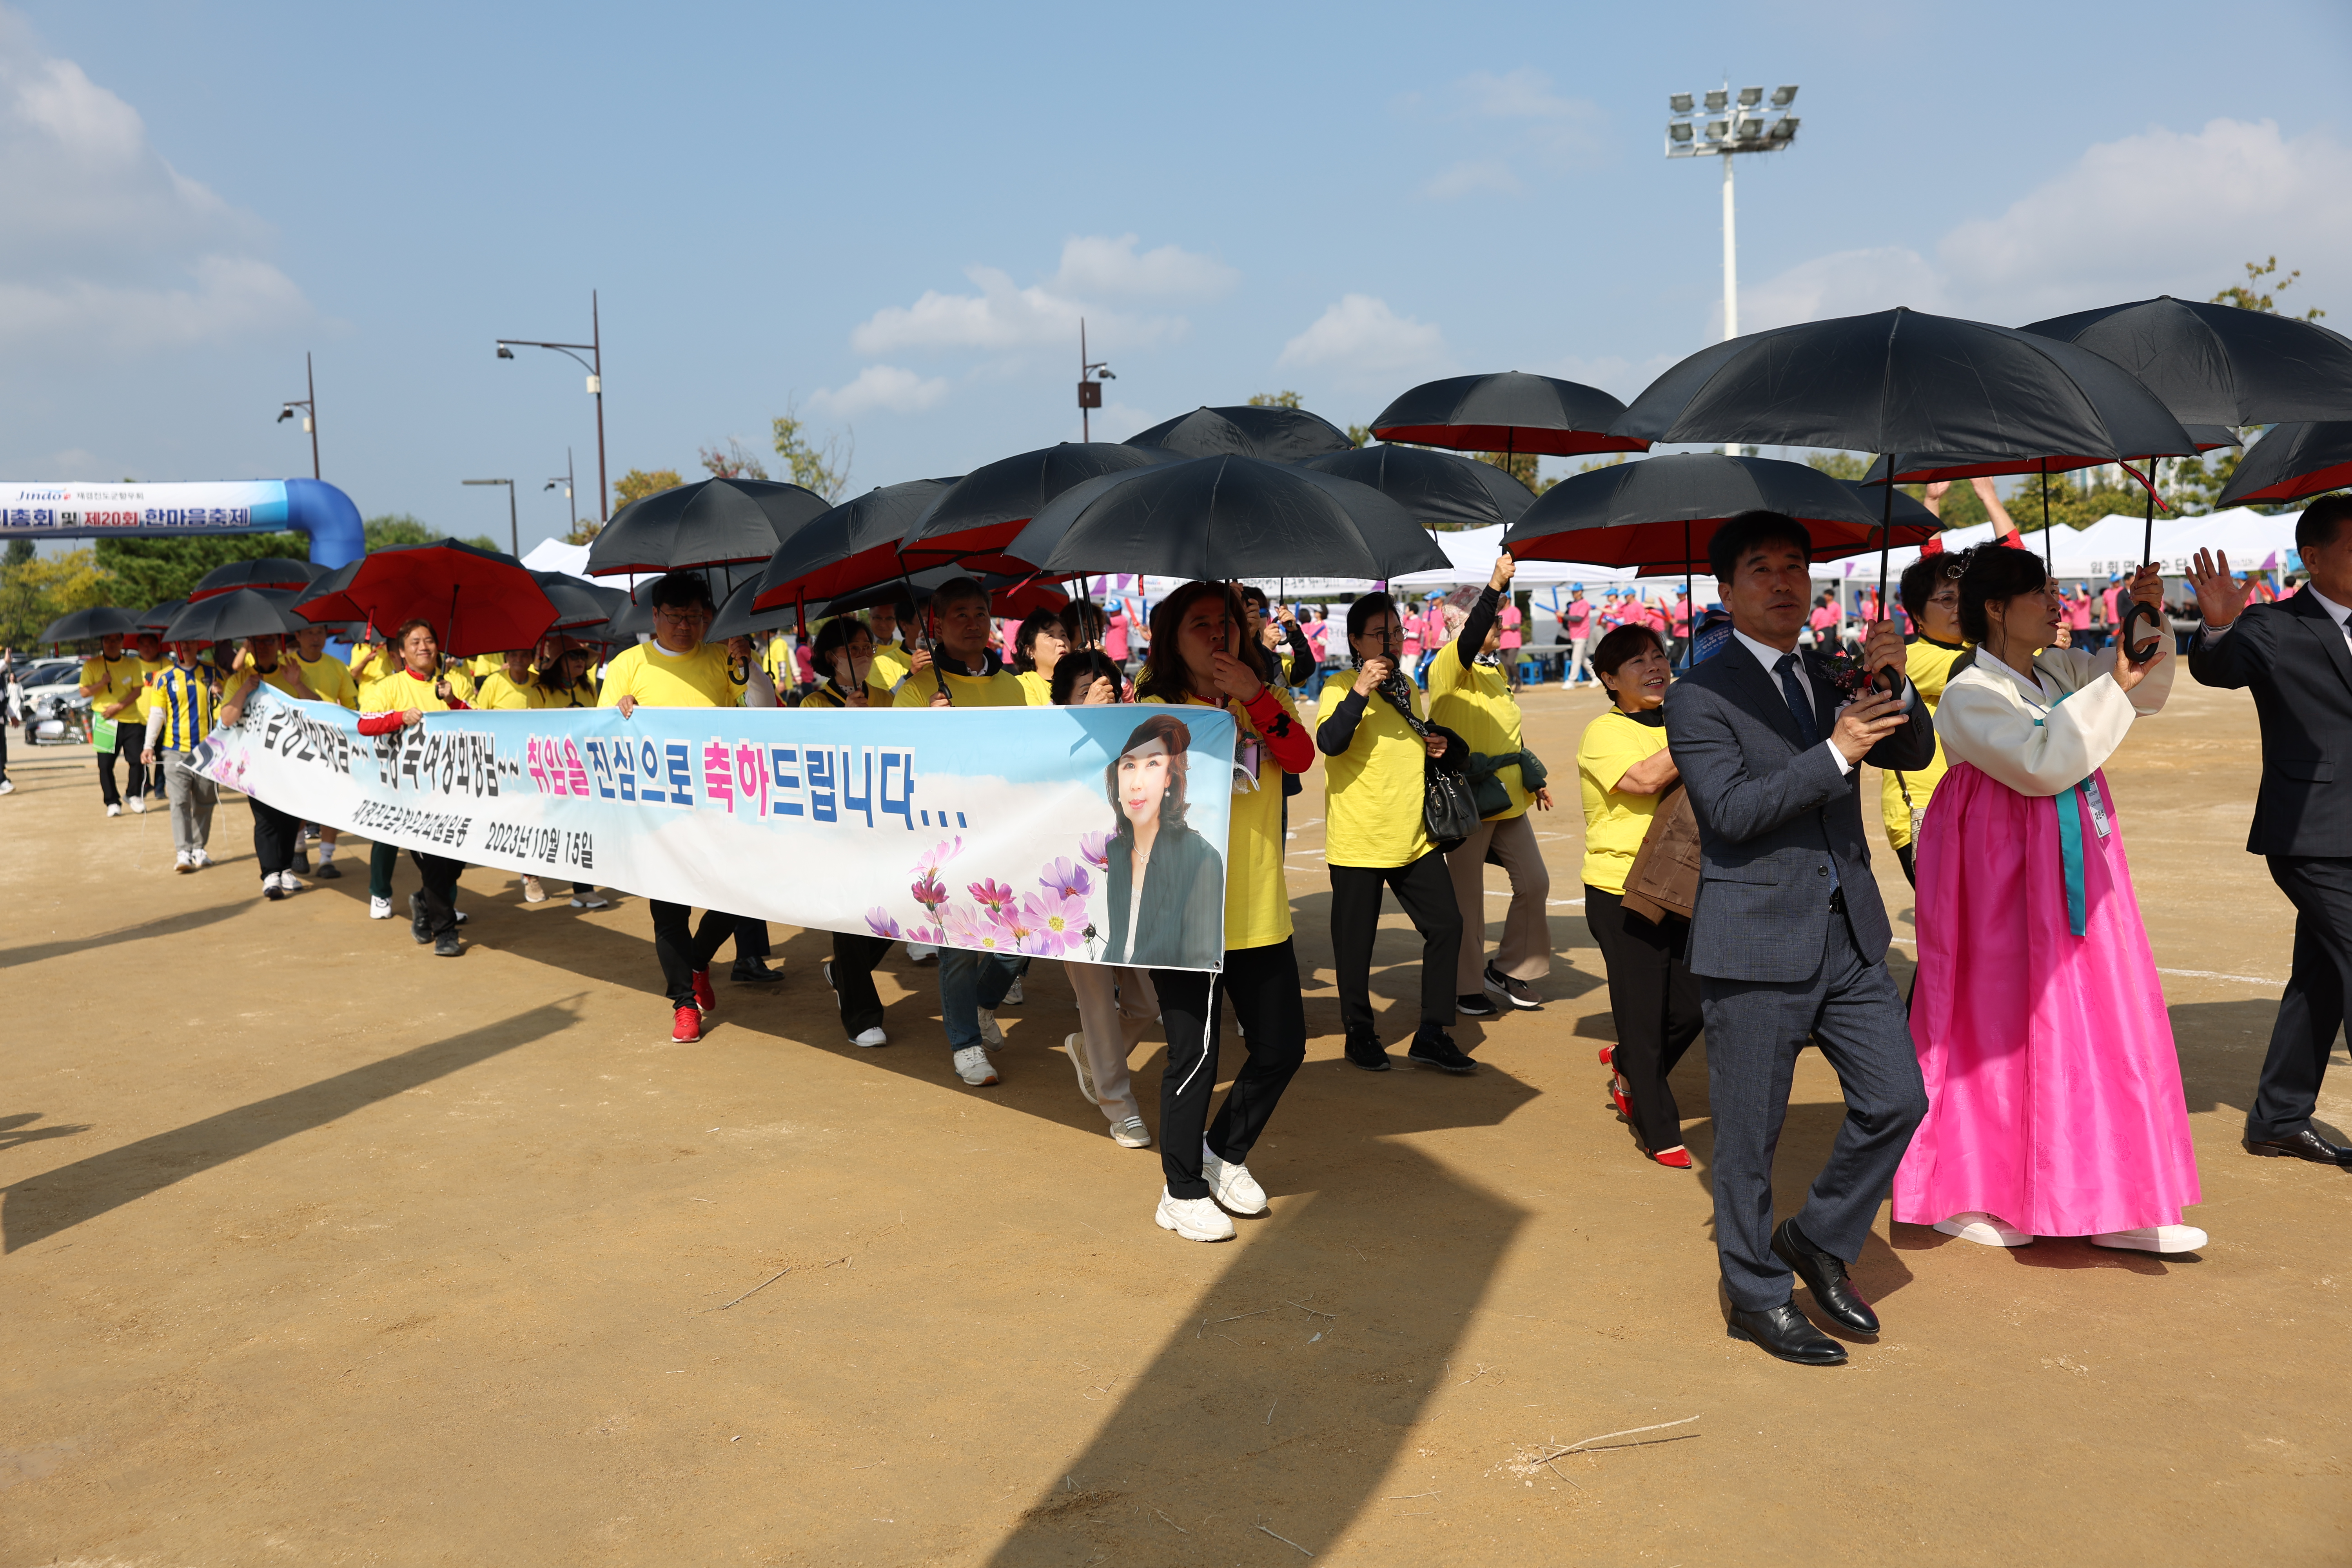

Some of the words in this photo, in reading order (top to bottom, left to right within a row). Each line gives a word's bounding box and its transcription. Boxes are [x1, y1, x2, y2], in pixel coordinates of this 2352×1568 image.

[16, 491, 62, 501] Jindo
[61, 512, 78, 526] 및
[84, 512, 138, 526] 제20회
[145, 508, 249, 527] 한마음축제
[528, 738, 590, 796] 취임을
[586, 740, 693, 806] 진심으로
[704, 742, 967, 831] 축하드립니다...
[565, 831, 593, 869] 15일
